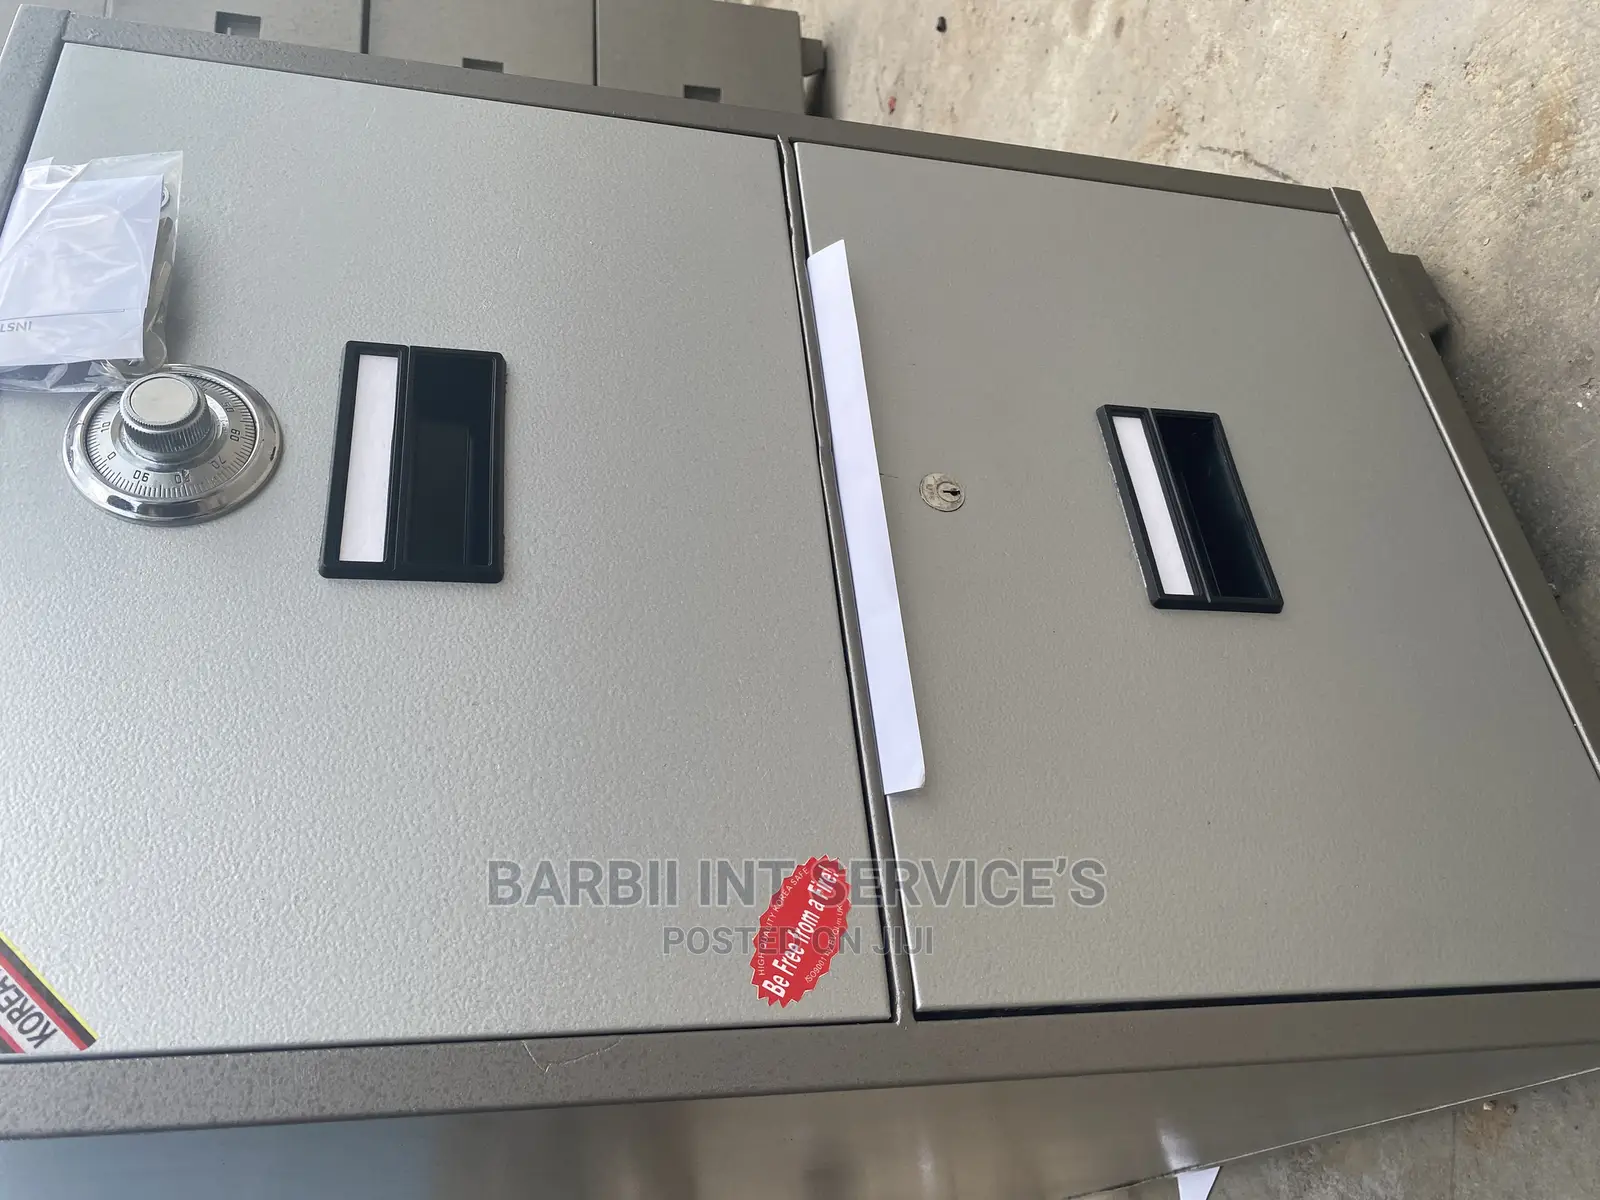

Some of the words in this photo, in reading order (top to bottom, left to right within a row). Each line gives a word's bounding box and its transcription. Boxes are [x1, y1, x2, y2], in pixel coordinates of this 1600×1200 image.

[229, 428, 241, 442] 60
[208, 456, 227, 470] 70
[132, 469, 151, 482] 90
[790, 867, 809, 886] SAFE
[807, 864, 840, 901] Fire!
[772, 885, 793, 911] KOREA
[808, 898, 826, 912] a
[760, 912, 777, 949] QUALITY
[787, 909, 821, 944] from
[757, 952, 766, 976] HIGH
[772, 942, 805, 977] Free
[804, 958, 827, 984] ISO9001
[762, 974, 790, 998] Be
